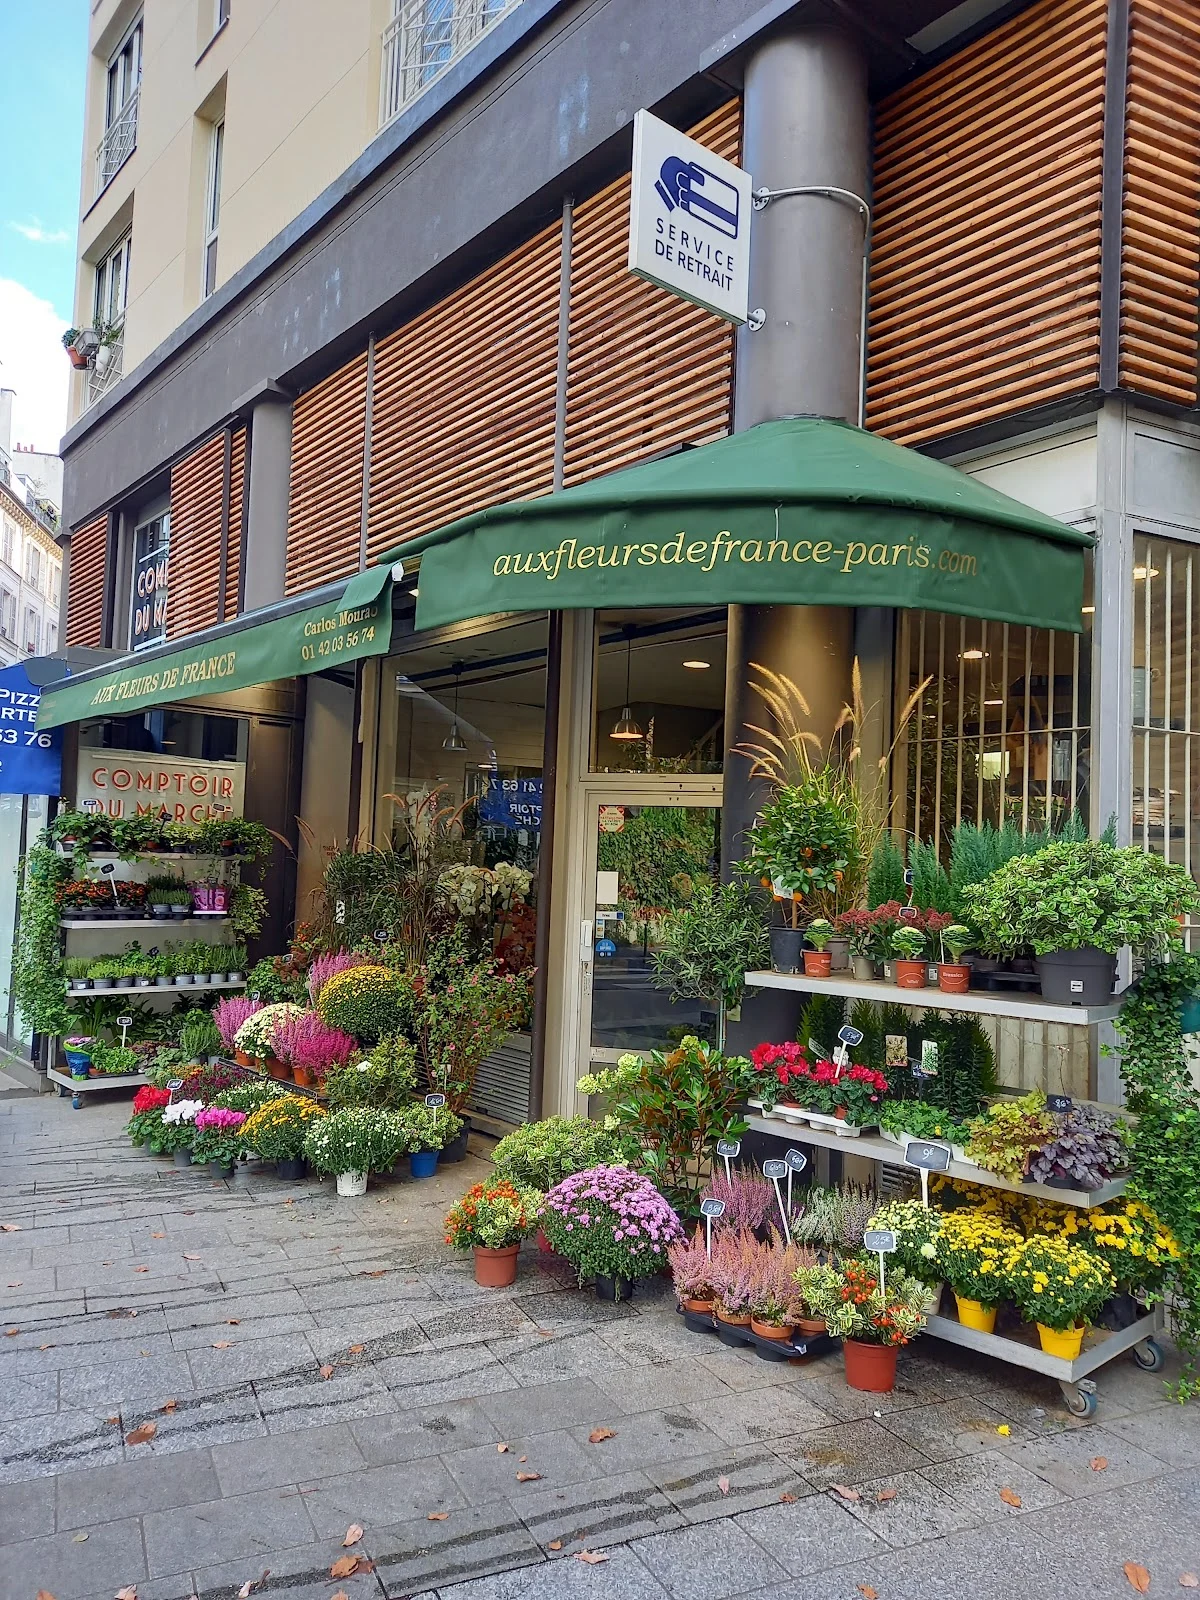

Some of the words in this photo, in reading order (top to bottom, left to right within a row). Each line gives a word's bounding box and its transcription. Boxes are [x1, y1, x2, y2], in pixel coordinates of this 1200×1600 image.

[656, 217, 734, 272] SERVICE
[655, 239, 673, 262] DE
[677, 250, 733, 291] RETRAIT
[493, 530, 977, 580] auxfleursdefrance-paris.com
[135, 603, 150, 636] DU
[304, 616, 336, 637] Carlos
[301, 644, 316, 660] 01
[318, 639, 331, 656] 42
[331, 635, 344, 652] 03
[346, 630, 359, 648] 56
[361, 626, 375, 643] 74
[90, 685, 117, 705] AUX
[114, 673, 160, 700] FLEURS
[160, 667, 180, 690] DE
[179, 651, 236, 686] FRANCE
[24, 731, 52, 748] 76
[91, 767, 235, 798] COMPTOIR
